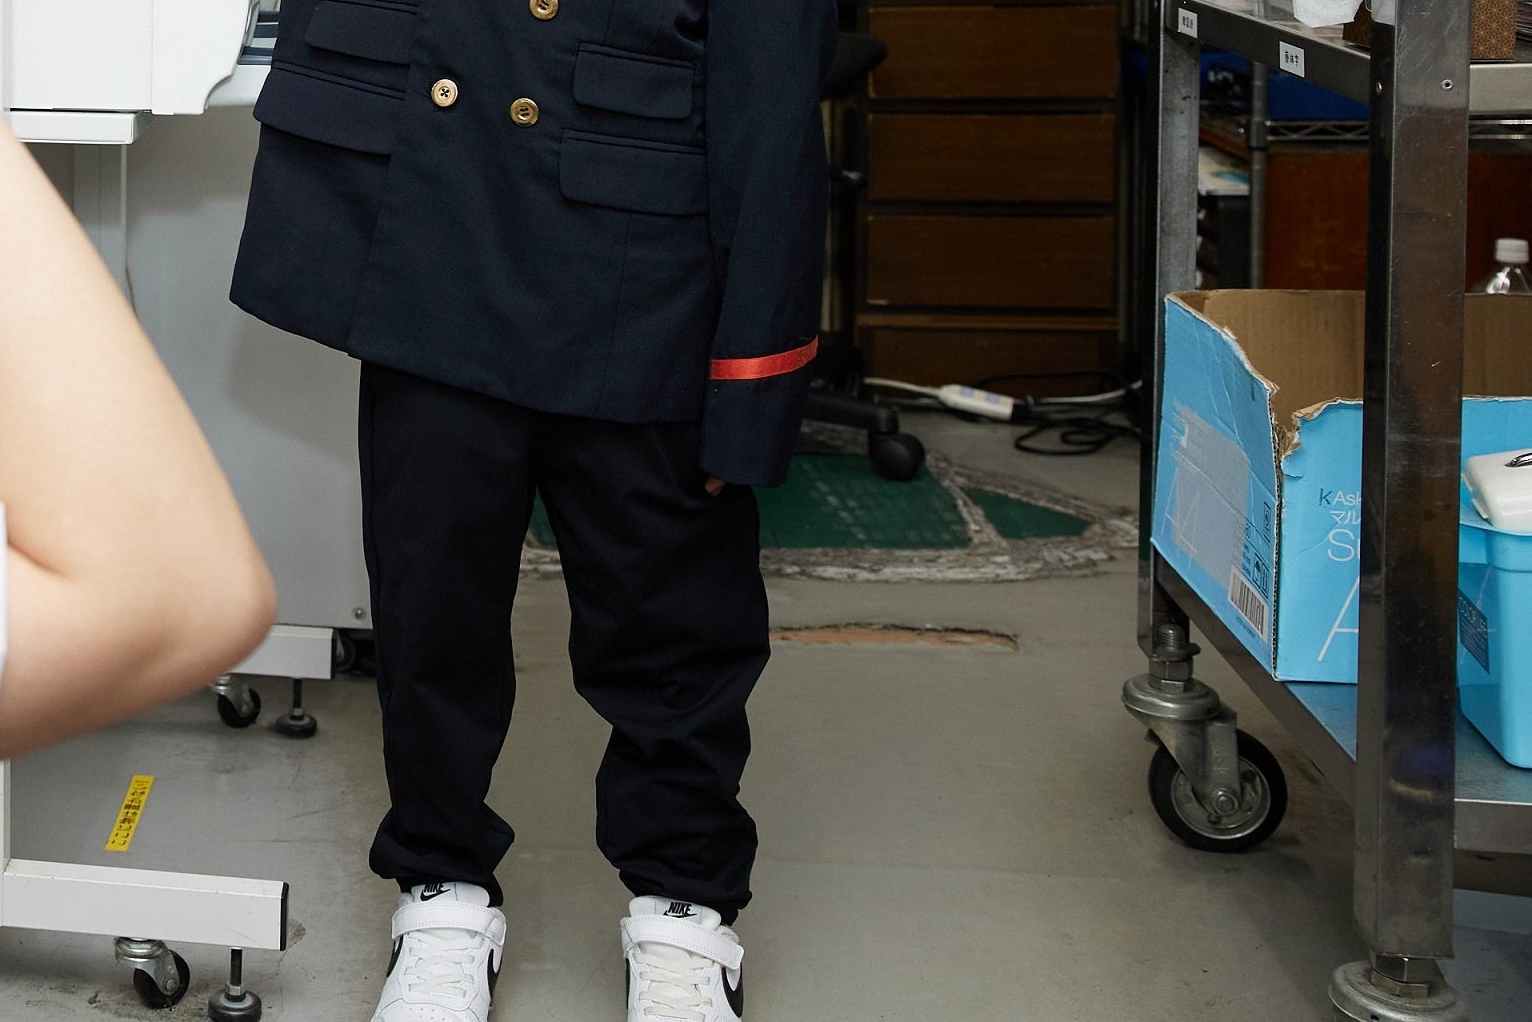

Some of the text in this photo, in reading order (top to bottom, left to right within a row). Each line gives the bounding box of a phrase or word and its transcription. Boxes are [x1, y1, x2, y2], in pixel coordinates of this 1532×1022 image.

[1327, 528, 1361, 563] S
[424, 881, 445, 893] NIKE
[667, 901, 693, 915] NIKE
